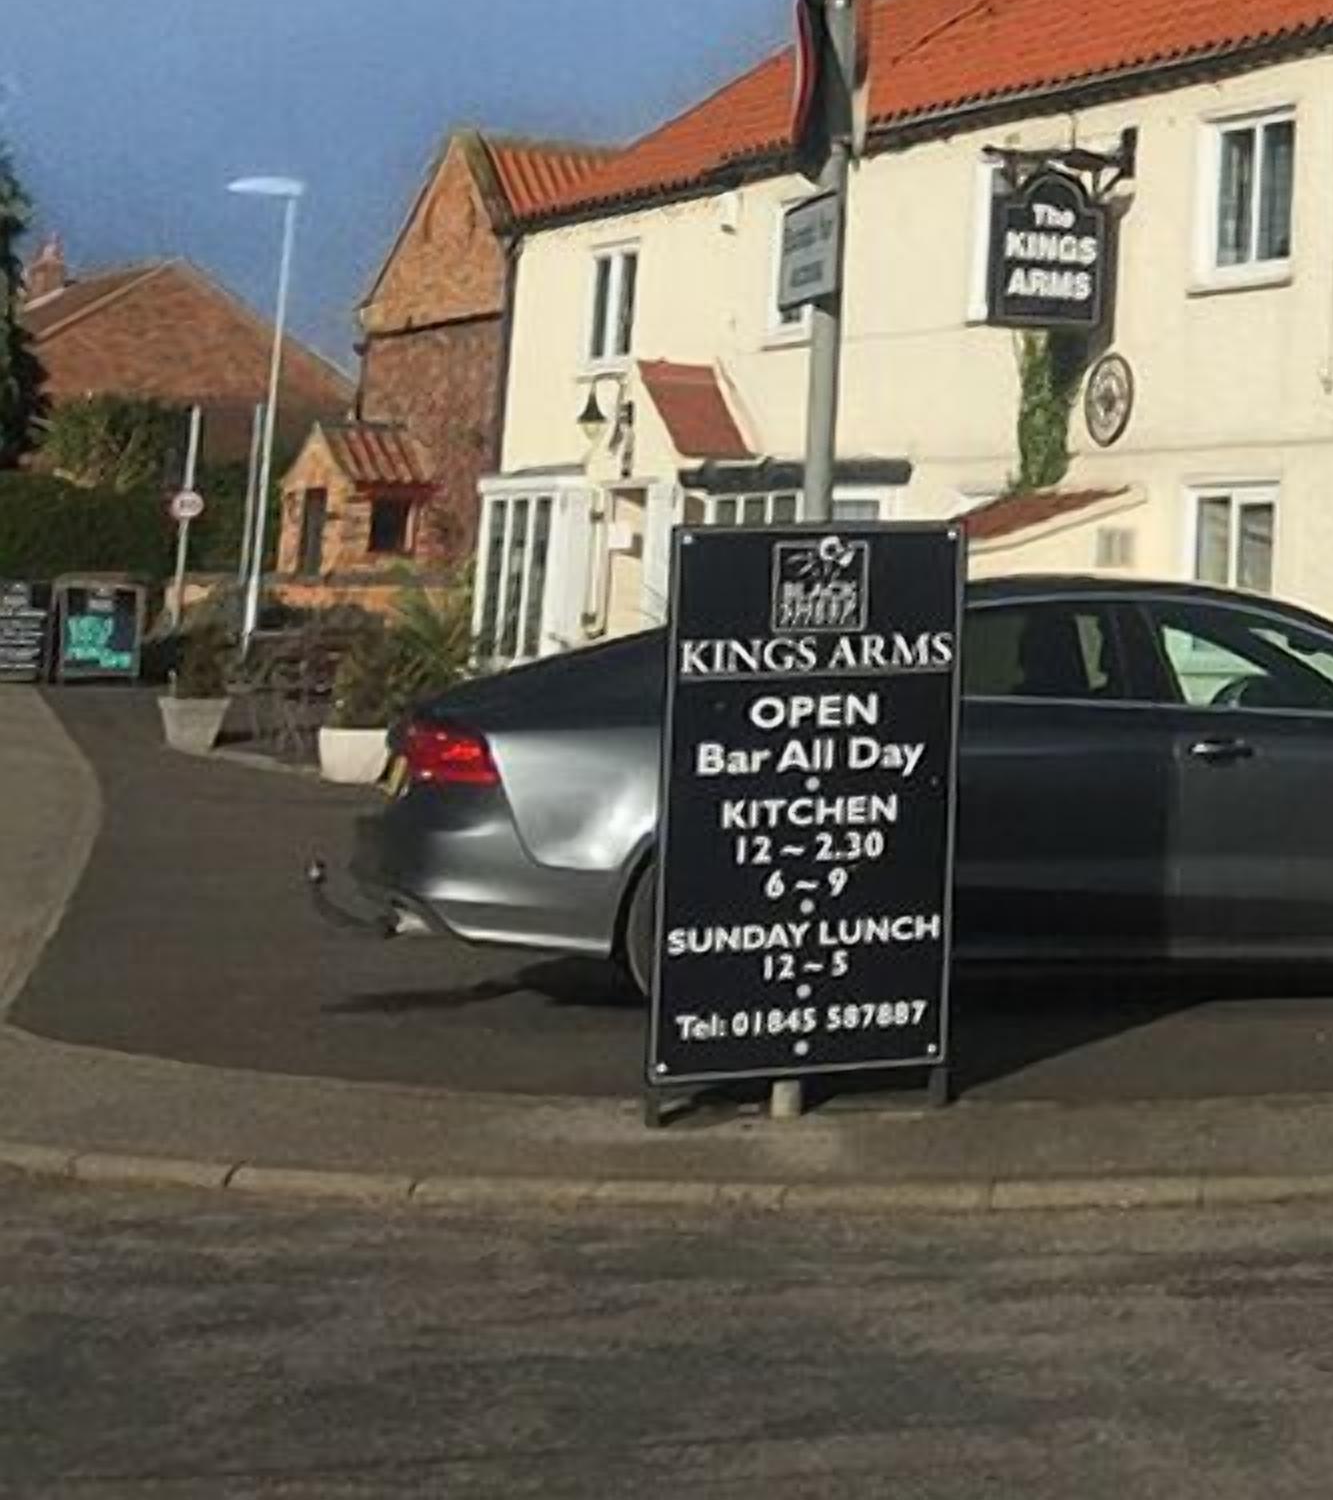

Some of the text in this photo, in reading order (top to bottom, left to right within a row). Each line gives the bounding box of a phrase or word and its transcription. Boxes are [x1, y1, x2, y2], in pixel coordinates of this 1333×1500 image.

[1004, 231, 1097, 264] KINGS
[1007, 267, 1093, 300] ARMS
[680, 631, 953, 674] KINGS ARMS
[749, 694, 879, 729] OPEN
[696, 737, 925, 777] Bar All Day
[721, 795, 899, 830] KITCHEN
[735, 836, 771, 865] 12
[815, 831, 885, 861] 2.30
[765, 869, 785, 899] 6
[828, 867, 849, 897] 9
[668, 915, 941, 956] SUNDAY LUNCH
[763, 953, 796, 980] 12
[830, 951, 849, 979] 5
[675, 1014, 726, 1041] Tel:
[731, 1009, 817, 1039] 01845
